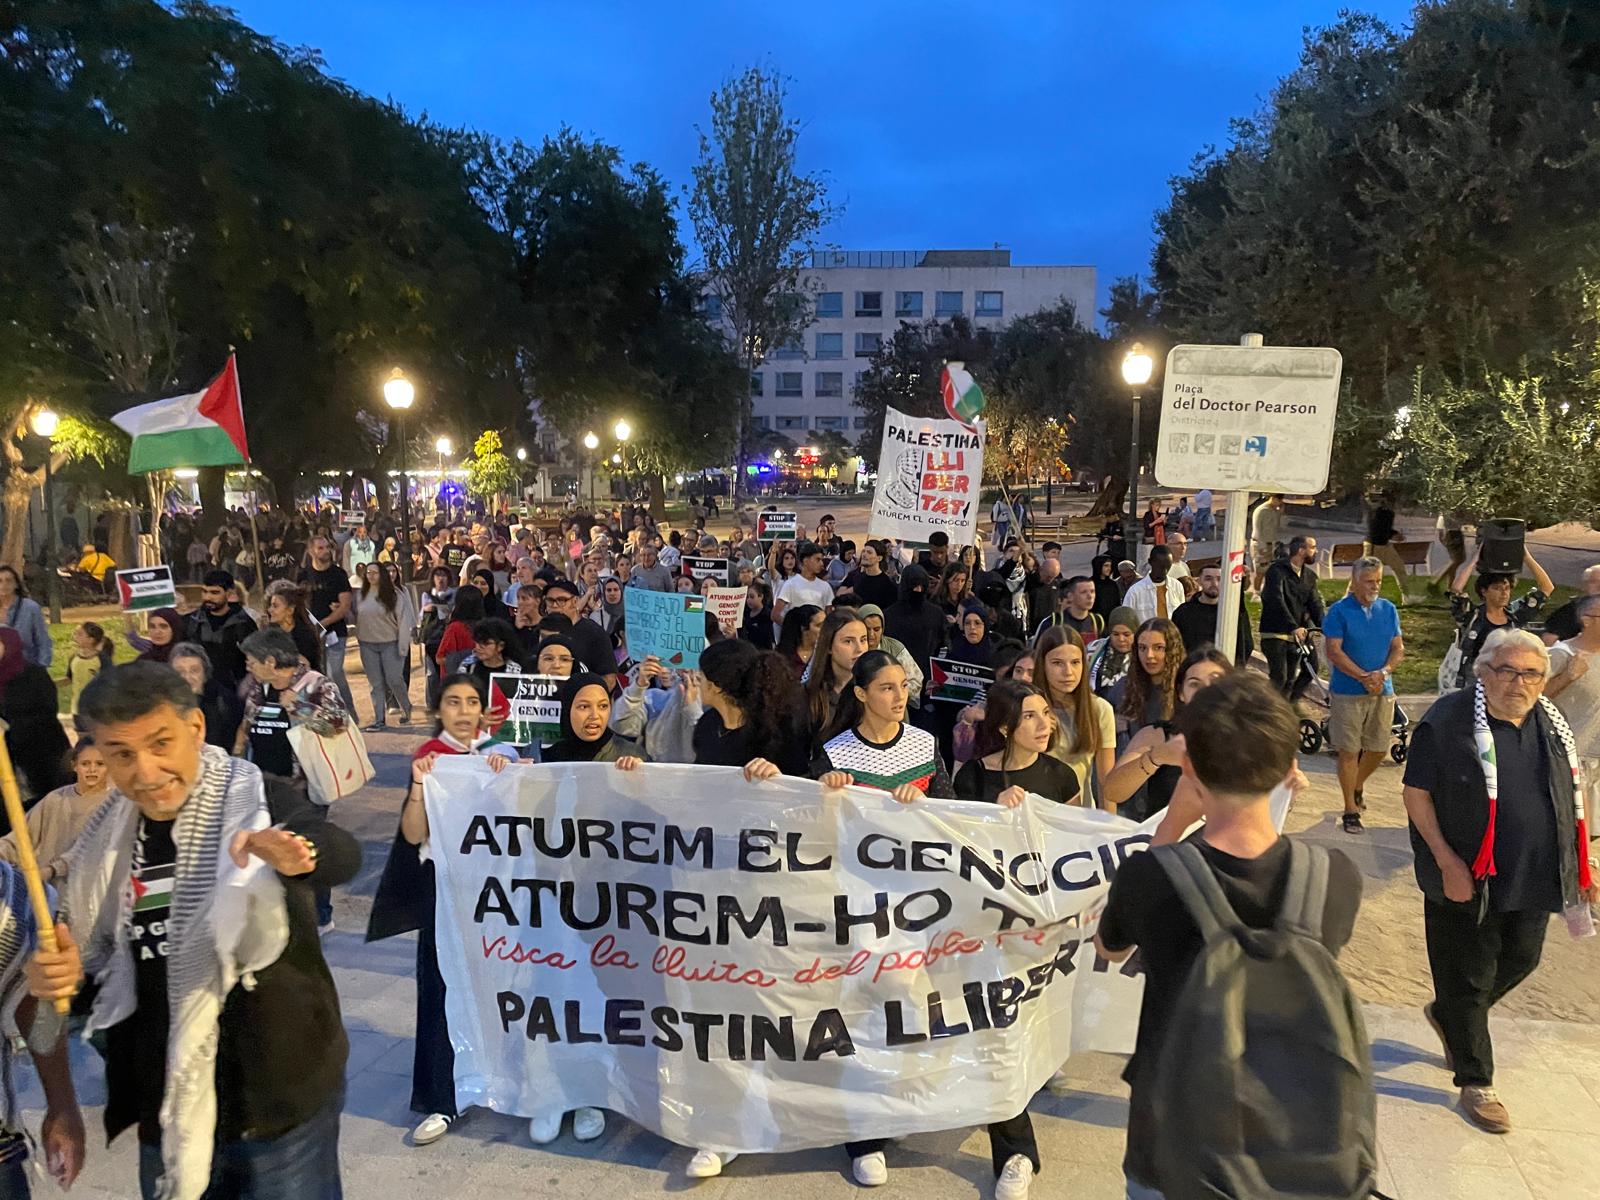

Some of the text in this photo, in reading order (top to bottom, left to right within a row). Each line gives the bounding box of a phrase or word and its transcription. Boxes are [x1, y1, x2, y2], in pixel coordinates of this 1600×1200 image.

[1175, 384, 1203, 396] Plaça
[1173, 397, 1317, 414] del Doctor Pearson
[888, 425, 980, 449] PALESTINA
[921, 473, 970, 494] BER
[877, 509, 911, 521] ATUREM
[912, 515, 923, 523] EL
[951, 664, 980, 675] STOP
[520, 682, 558, 697] STOP
[518, 705, 559, 717] GENOCI
[459, 814, 714, 869] ATUREM
[738, 828, 833, 872] EL
[473, 876, 953, 946] ATUREM-HO
[482, 934, 578, 970] Visca
[590, 934, 640, 968] la
[651, 944, 778, 988] lluita
[793, 950, 873, 984] del
[496, 990, 856, 1063] PALESTINA
